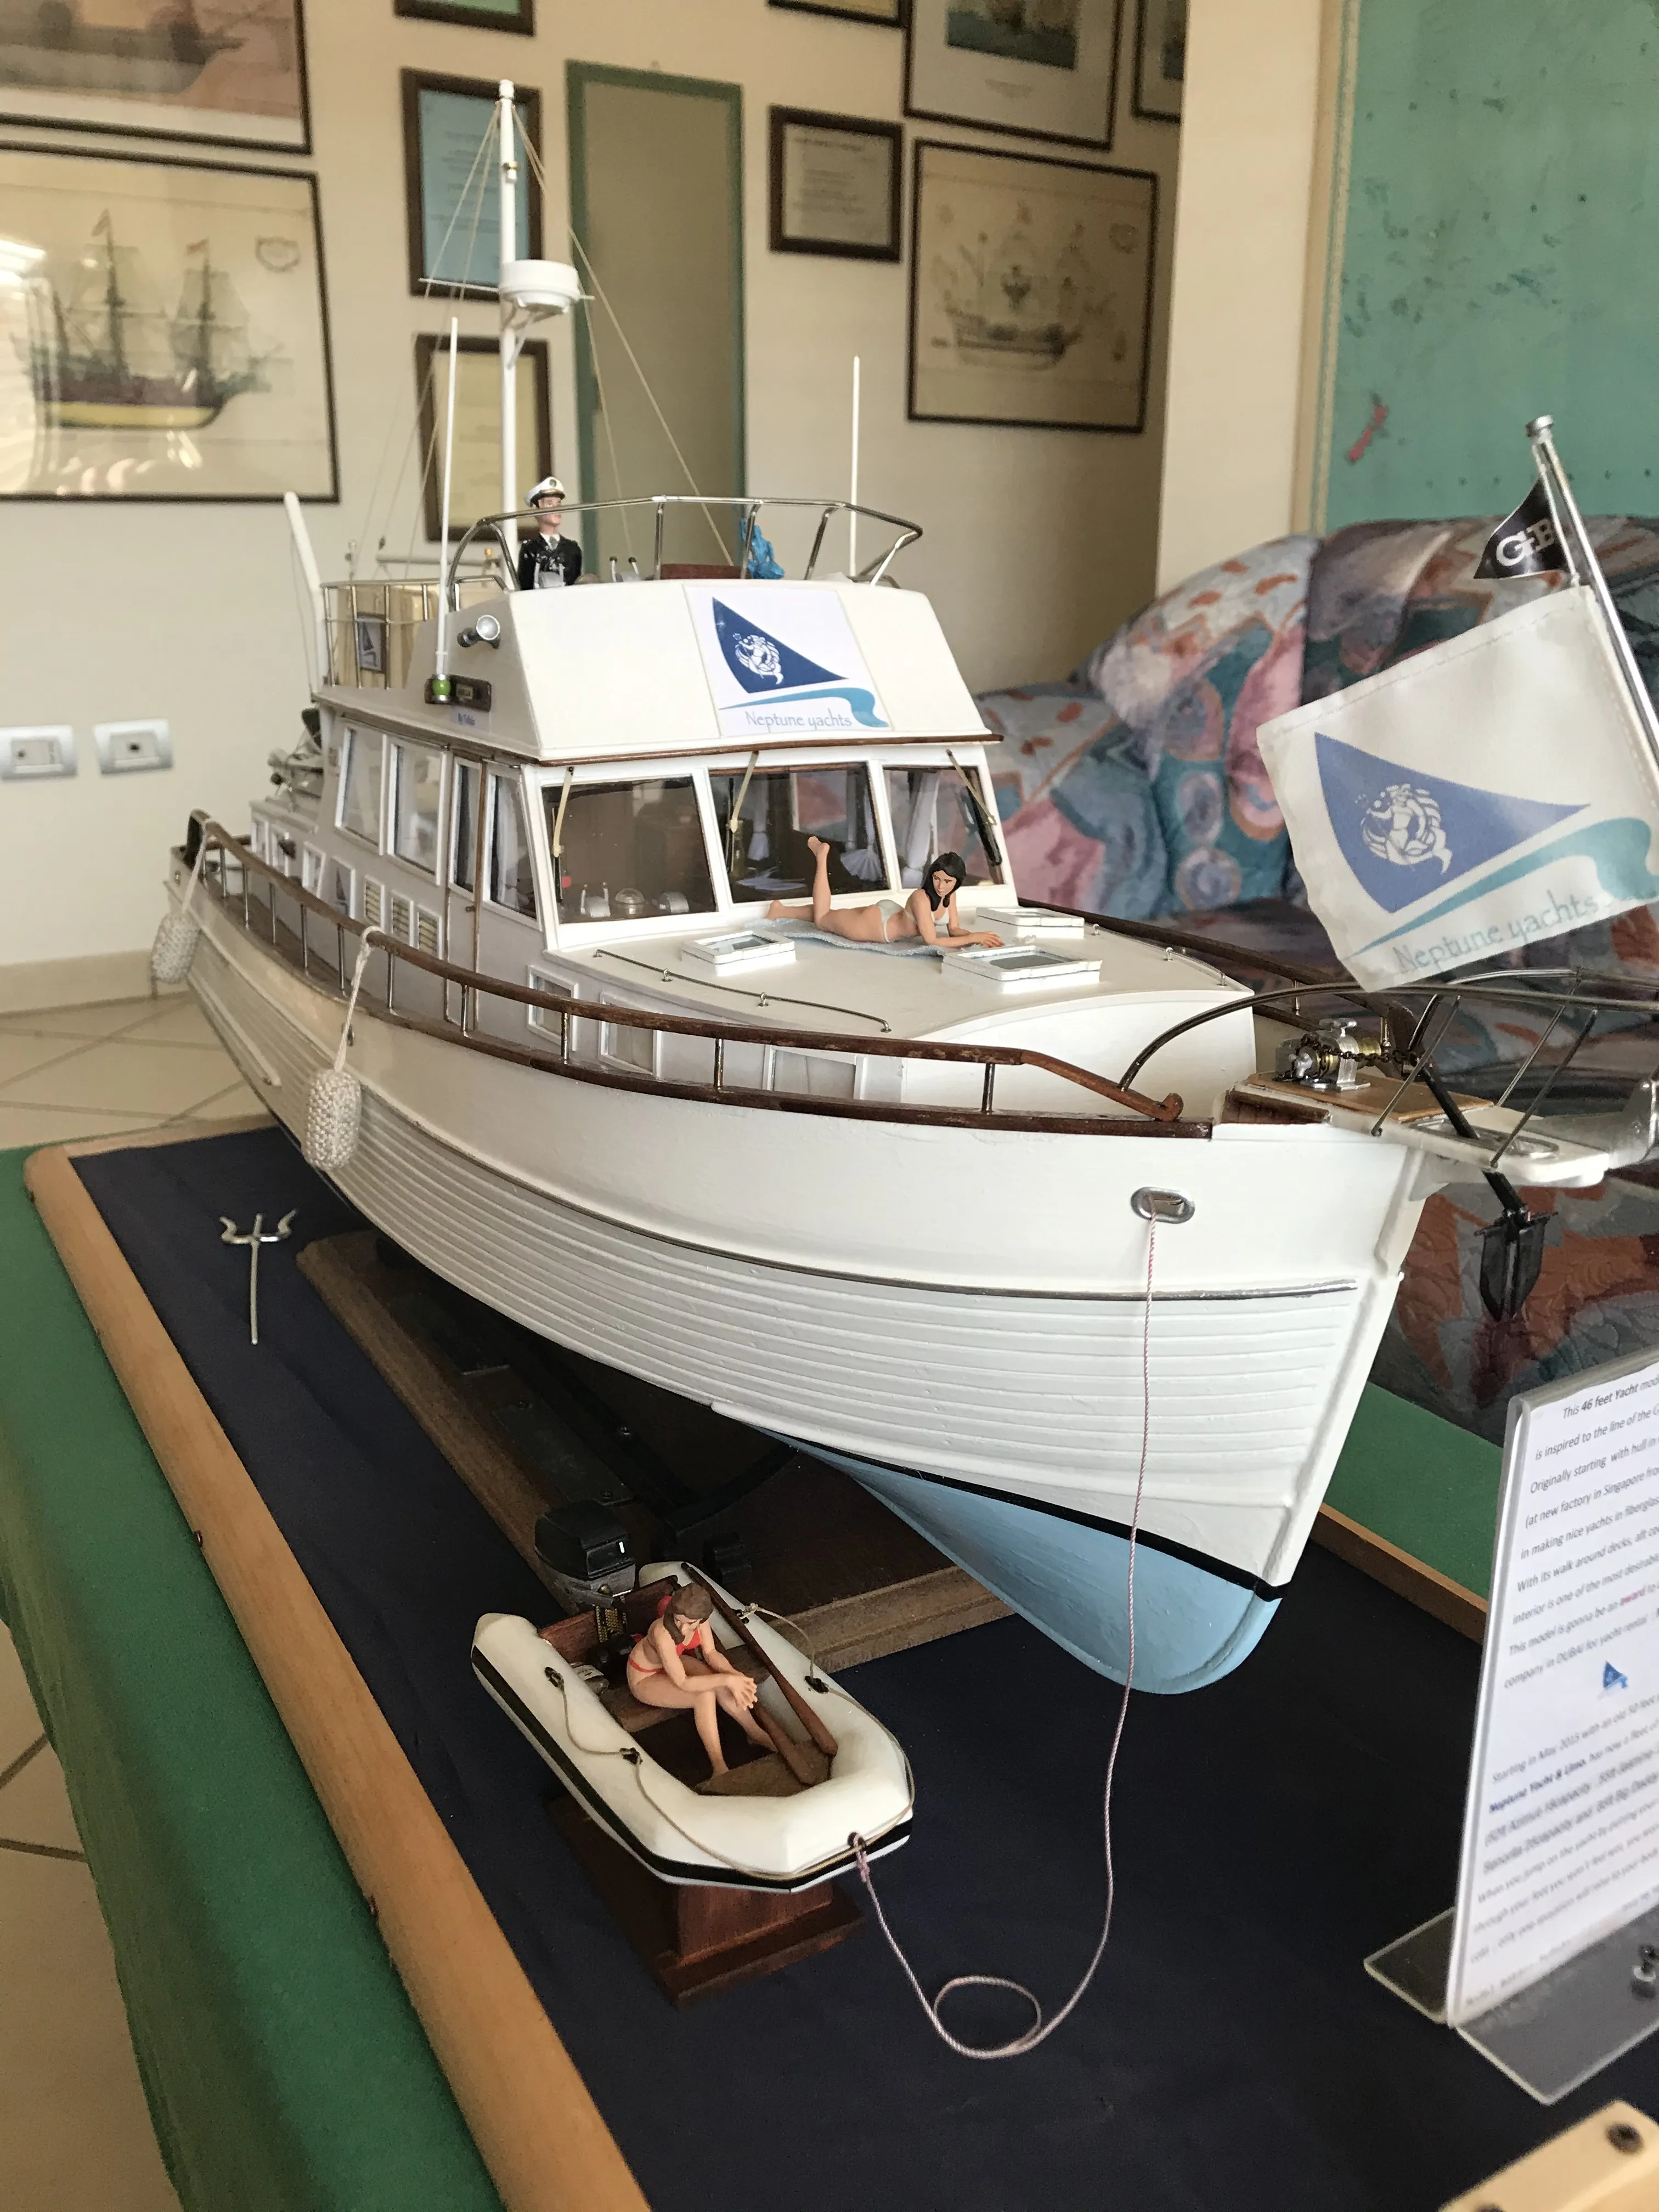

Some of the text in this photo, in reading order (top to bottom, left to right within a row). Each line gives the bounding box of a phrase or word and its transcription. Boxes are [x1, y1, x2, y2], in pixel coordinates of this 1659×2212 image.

[745, 707, 852, 733] Neptune yachts
[1392, 889, 1599, 972] Neptune yachts
[1564, 1405, 1579, 1418] This
[1581, 1398, 1593, 1410] 46
[1595, 1393, 1613, 1407] feet
[1616, 1384, 1639, 1400] Yacht
[1536, 1450, 1542, 1460] is
[1545, 1434, 1580, 1457] inspired
[1582, 1433, 1591, 1443] to
[1594, 1426, 1607, 1438] the
[1609, 1420, 1625, 1432] line
[1627, 1415, 1636, 1426] of
[1638, 1410, 1651, 1422] the
[1531, 1469, 1571, 1494] Originally
[1573, 1457, 1606, 1477] starting
[1611, 1447, 1629, 1462] with
[1525, 1515, 1537, 1529] (at
[1539, 1506, 1558, 1521] new
[1561, 1494, 1591, 1513] factory
[1593, 1488, 1601, 1500] in
[1604, 1472, 1644, 1496] Singapore
[1521, 1549, 1529, 1559] in
[1532, 1535, 1564, 1555] making
[1565, 1527, 1583, 1542] nice
[1585, 1516, 1612, 1535] yachts
[1615, 1511, 1623, 1521] in
[1517, 1575, 1538, 1592] With
[1541, 1571, 1551, 1582] its
[1553, 1560, 1573, 1577] walk
[1575, 1545, 1606, 1567] around
[1513, 1603, 1545, 1625] interior
[1547, 1599, 1554, 1609] is
[1556, 1592, 1573, 1605] one
[1575, 1583, 1585, 1598] of
[1585, 1580, 1600, 1593] the
[1602, 1569, 1623, 1585] most
[1510, 1641, 1526, 1656] This
[1528, 1626, 1556, 1647] model
